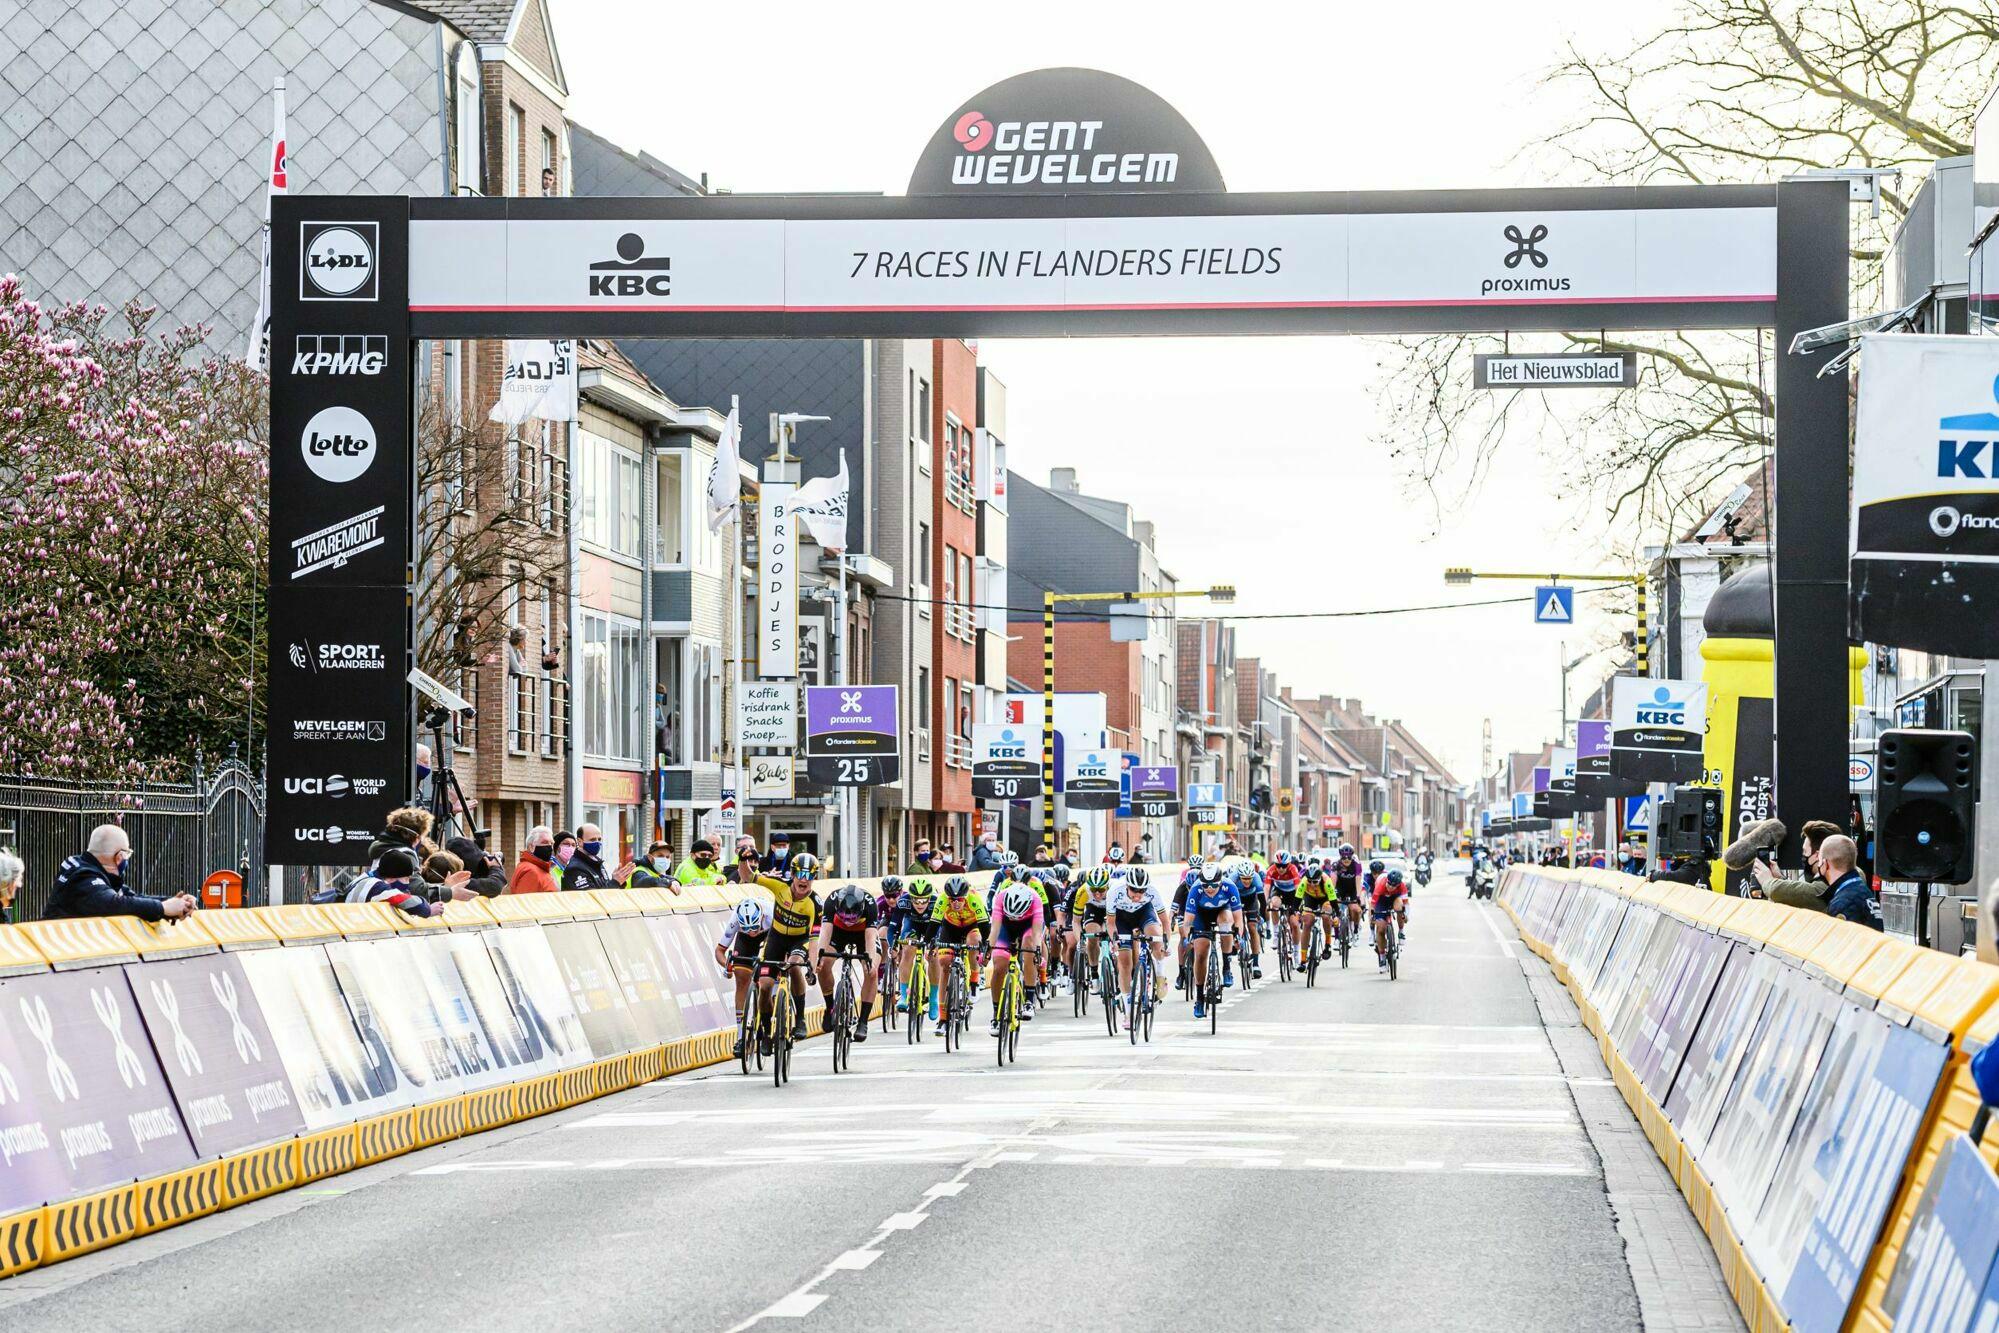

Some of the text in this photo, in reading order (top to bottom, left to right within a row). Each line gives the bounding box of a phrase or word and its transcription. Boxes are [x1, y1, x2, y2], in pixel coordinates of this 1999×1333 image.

[994, 121, 1103, 151] GENT
[951, 153, 1179, 184] WEVELGEM
[850, 247, 1282, 278] 7 RACES IN FLANDERS FIELDS
[589, 274, 670, 296] KBC
[1481, 277, 1571, 296] proximus
[291, 352, 383, 375] KPMG
[1491, 361, 1619, 380] Het Nieuwsblad
[1938, 440, 1999, 478] K
[297, 517, 379, 568] KWAREMONT
[770, 505, 785, 651] BROODJES
[319, 644, 385, 659] SPORT.
[319, 660, 385, 669] VLAANDEREN
[748, 687, 780, 699] Koffie
[293, 720, 365, 731] WEVELGEM
[746, 716, 783, 727] Snacks
[830, 716, 873, 726] proximus
[1636, 711, 1685, 725] KBC
[293, 732, 366, 740] SPREEKT JE AAN
[990, 748, 1025, 758] KBC
[838, 759, 869, 782] 25
[1078, 768, 1106, 776] KBC
[1850, 766, 1868, 775] SSO
[284, 778, 386, 794] UCI WORLD
[354, 787, 379, 795] TOUR
[995, 779, 1018, 796] 50
[1738, 775, 1759, 826] ORT.
[1143, 803, 1166, 816] 100
[1197, 812, 1215, 822] 150
[294, 828, 324, 841] UCI
